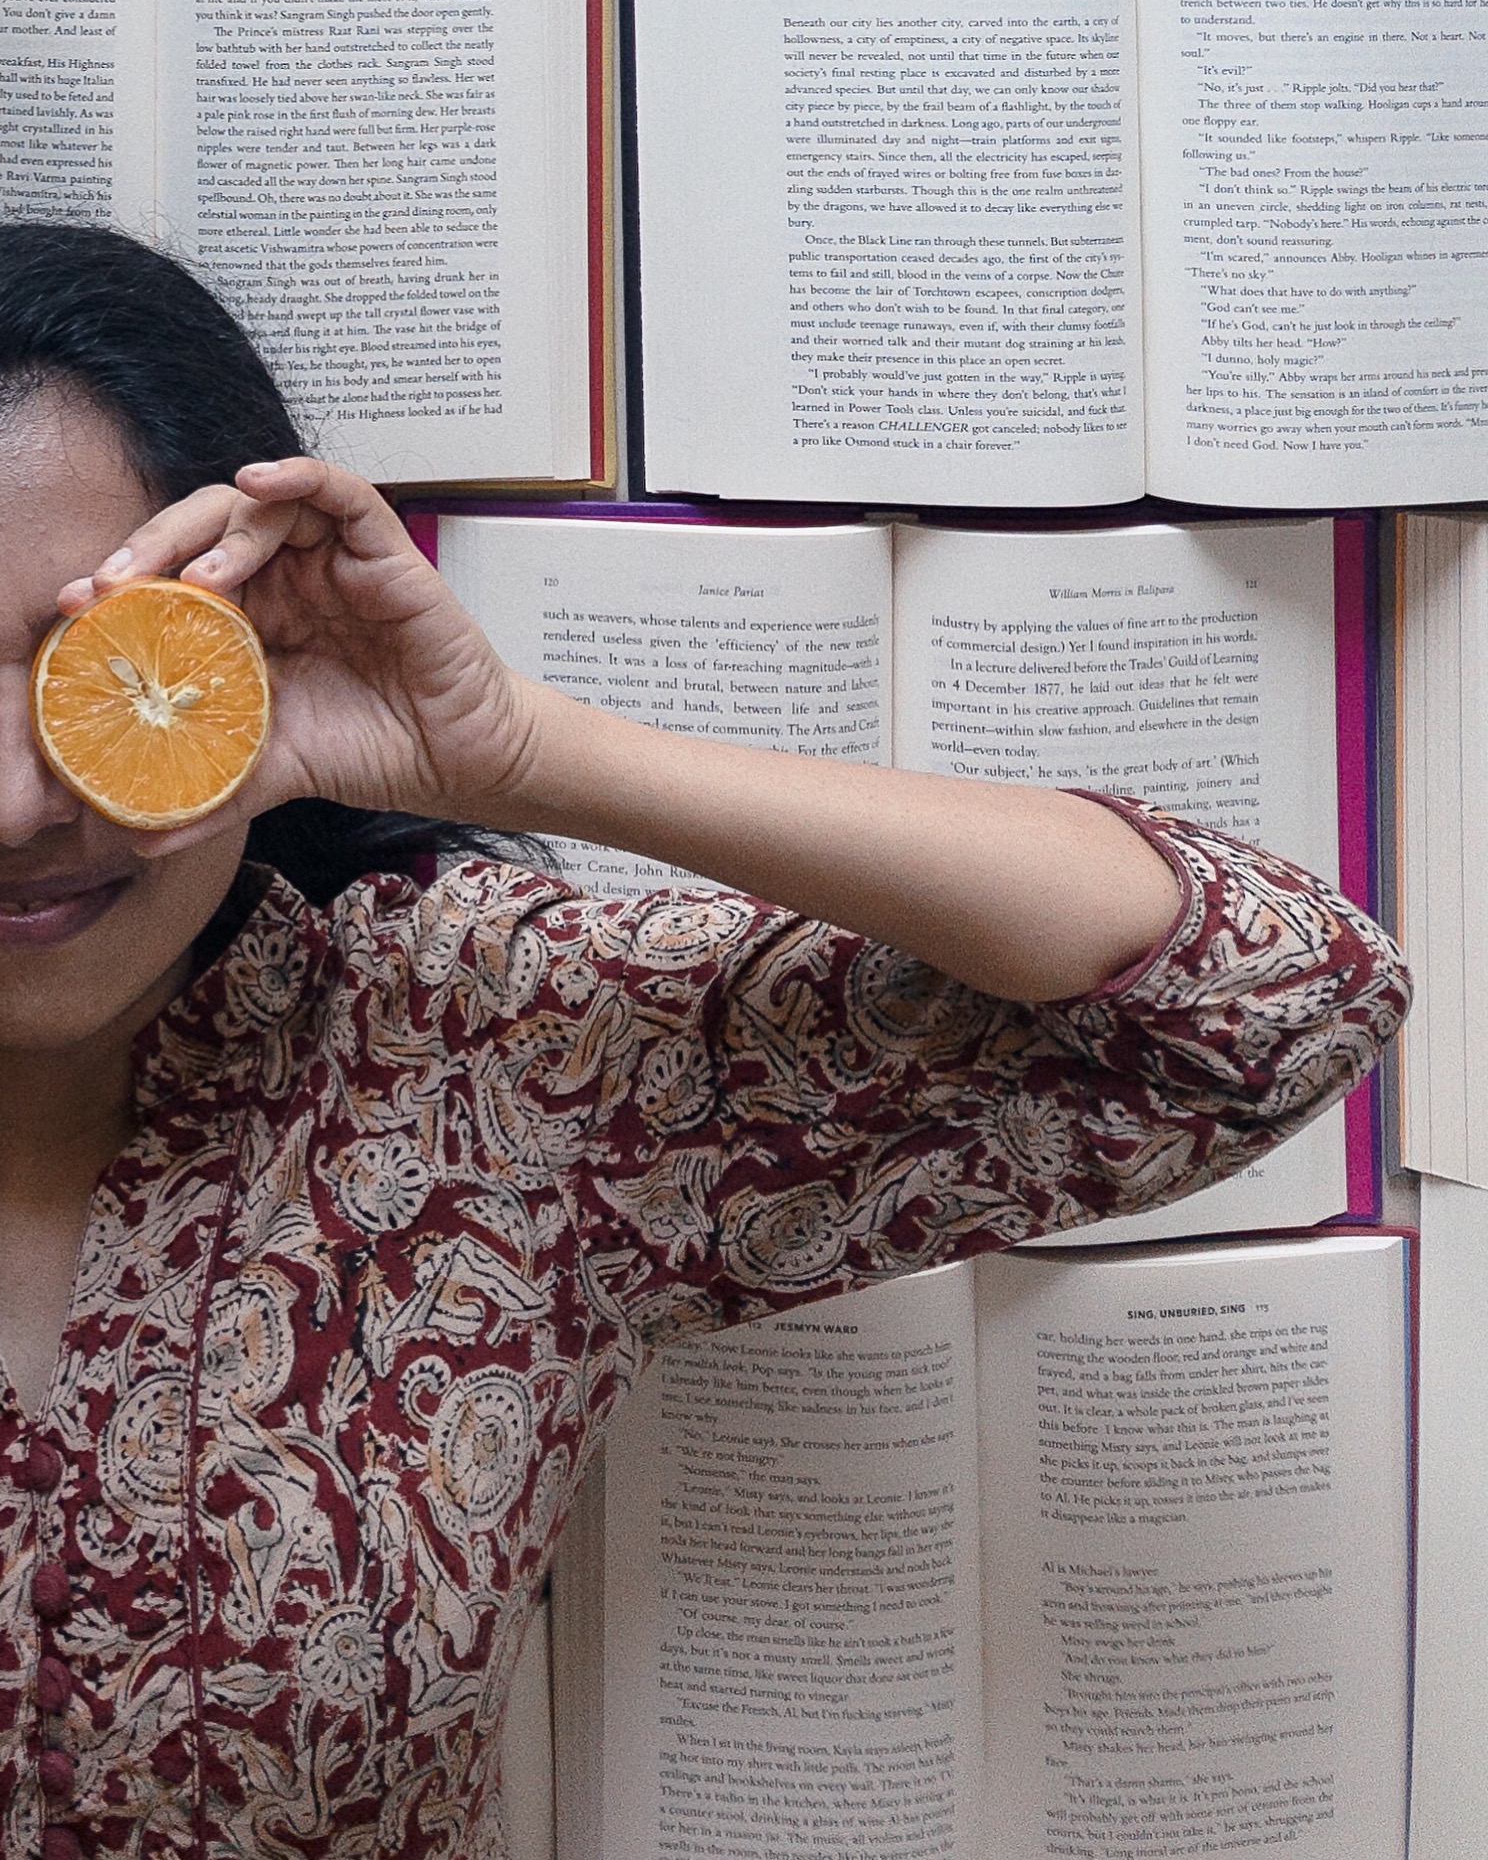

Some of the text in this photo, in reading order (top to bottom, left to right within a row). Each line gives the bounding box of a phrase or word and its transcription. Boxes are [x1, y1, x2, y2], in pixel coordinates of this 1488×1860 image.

[197, 239, 499, 256] great ascetic Vishwamitra whose powers of concentration were
[790, 350, 1065, 369] they make their presence in this place an open secret.
[543, 576, 560, 587] 120
[697, 583, 764, 598] Janice Pariat
[1048, 583, 1175, 600] William Morris in Balipara
[930, 672, 1259, 696] on 4 December 1877, he laid out ideas that he felt were
[1126, 1303, 1246, 1320] SING, UNBURIED, SING
[773, 1322, 821, 1334] JESMYN
[823, 1324, 859, 1335] WARD
